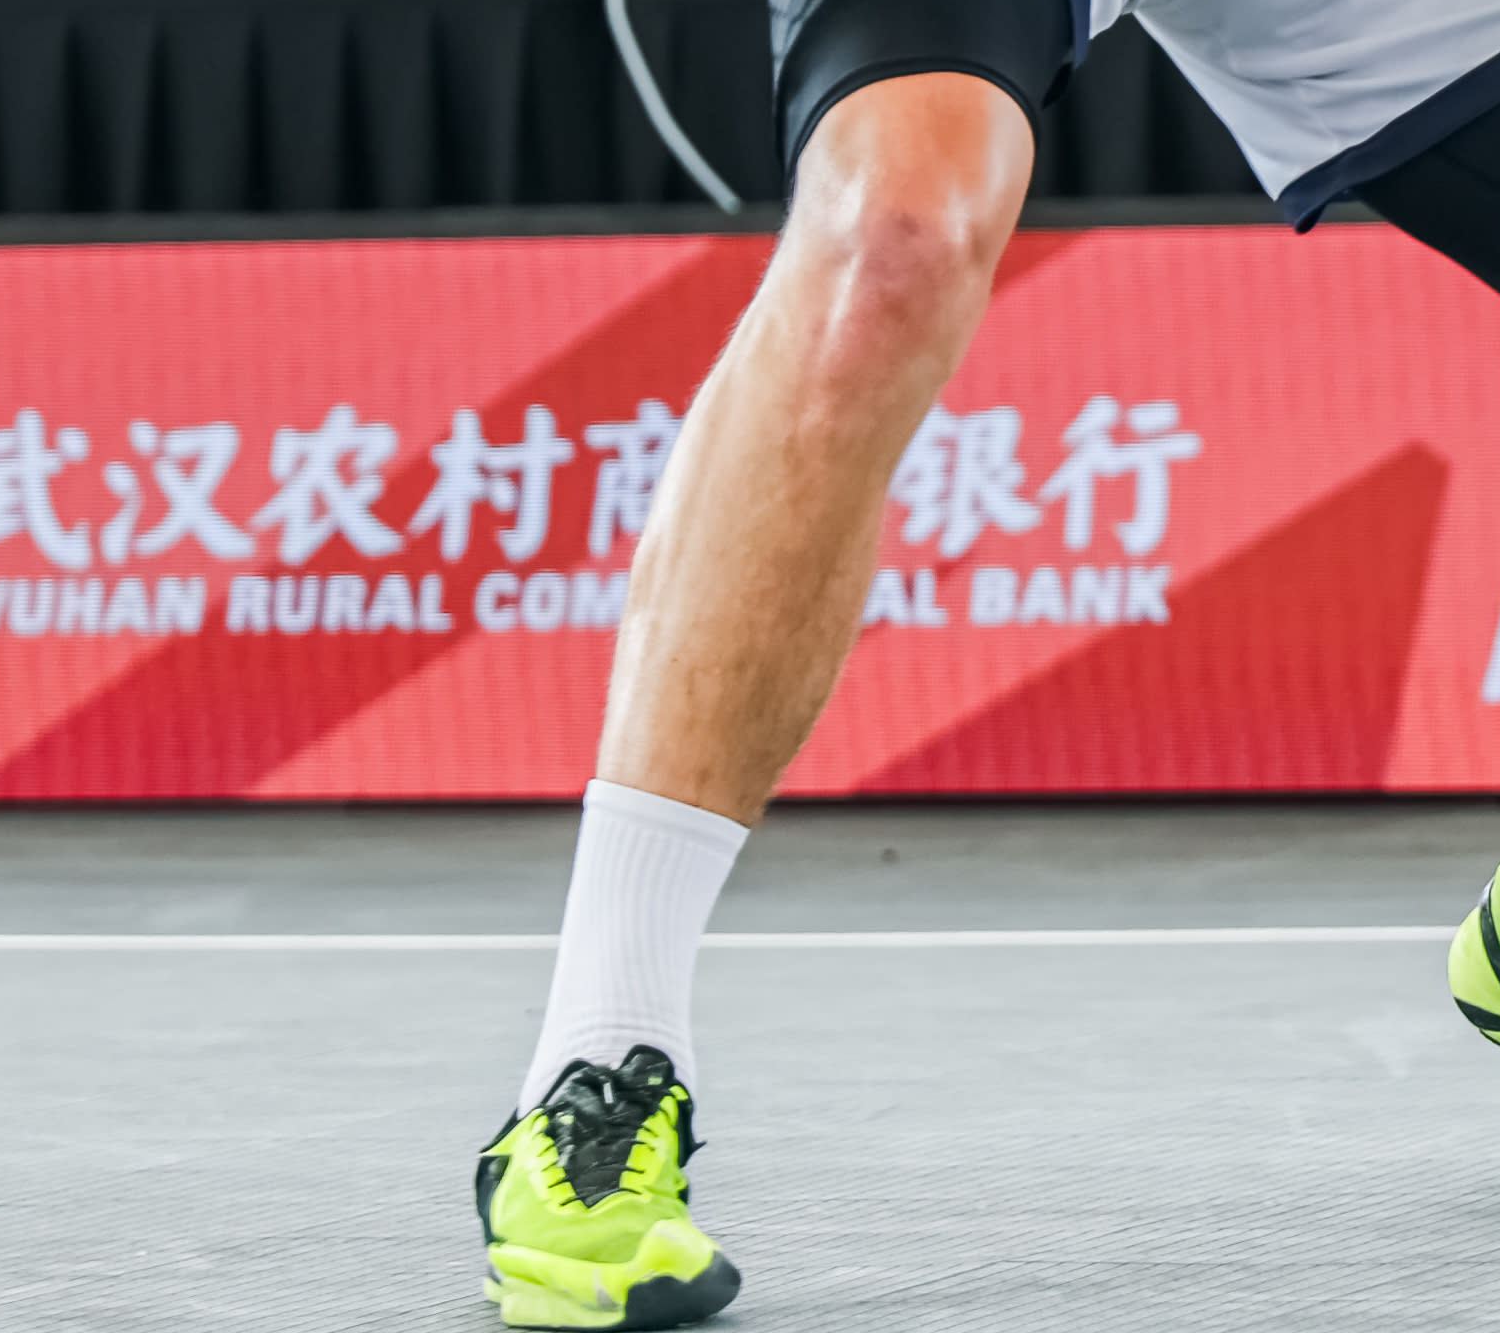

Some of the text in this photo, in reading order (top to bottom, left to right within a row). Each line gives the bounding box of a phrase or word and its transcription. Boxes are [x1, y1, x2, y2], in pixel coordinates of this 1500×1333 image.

[226, 573, 453, 633] RURAL
[475, 569, 947, 631] COMAL
[970, 565, 1171, 626] BANK
